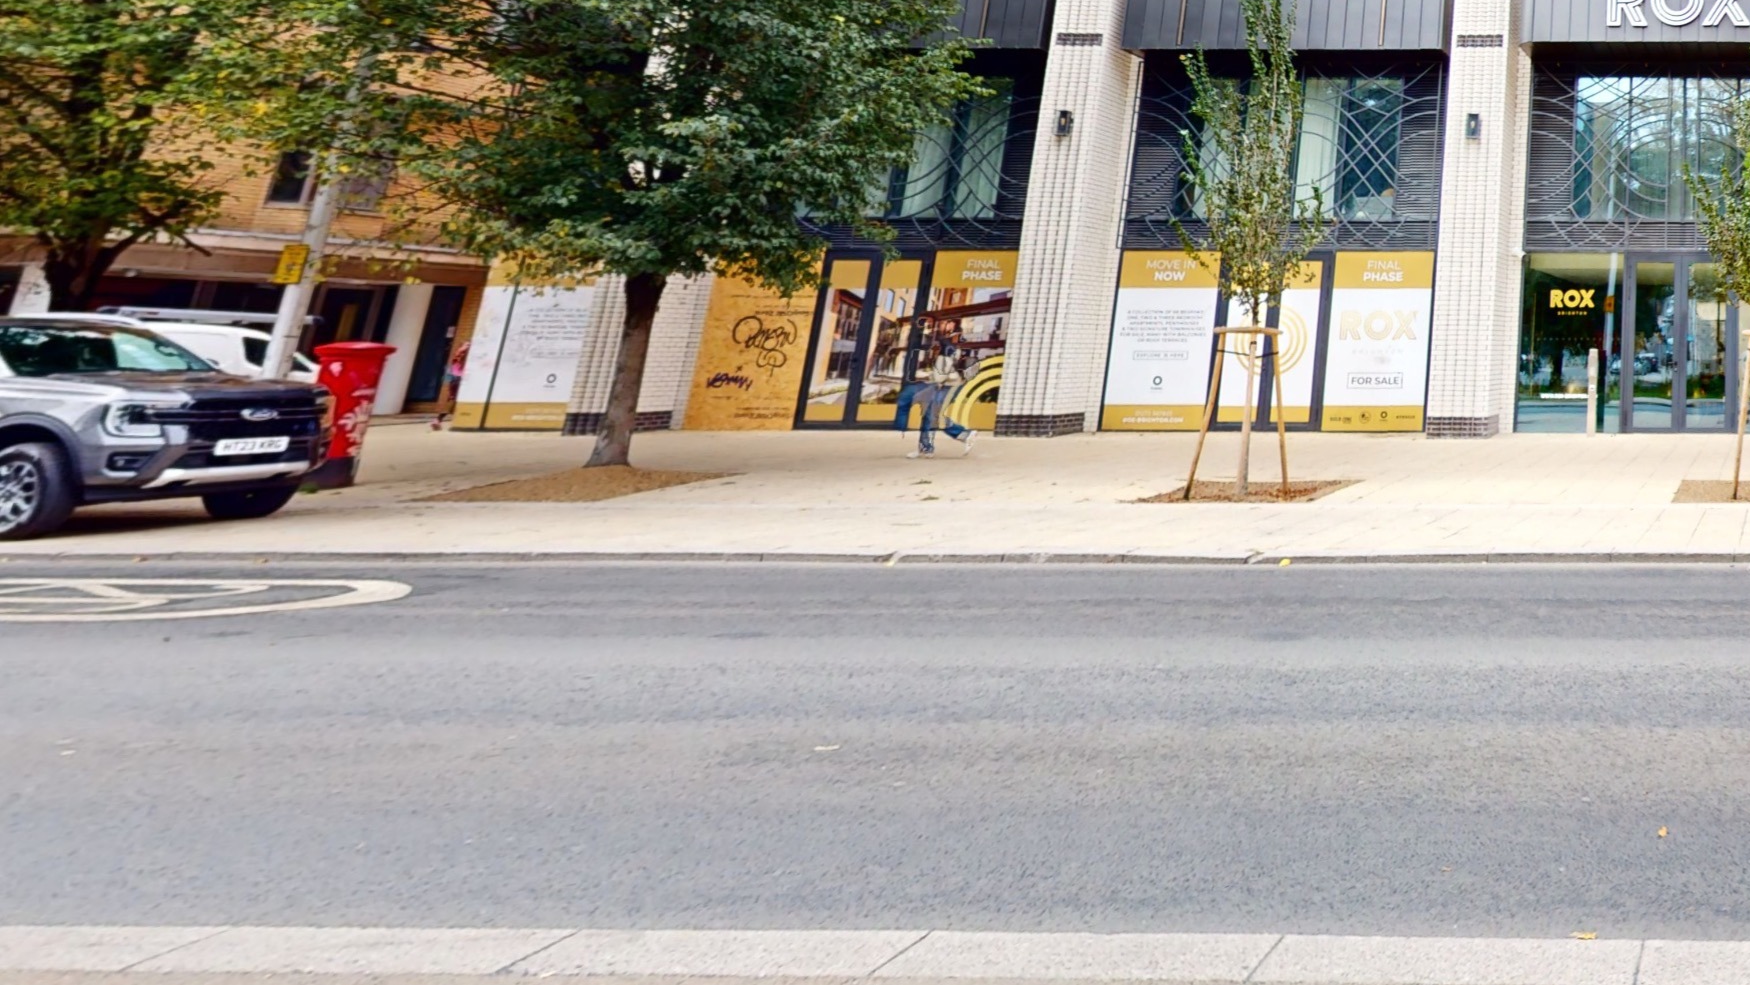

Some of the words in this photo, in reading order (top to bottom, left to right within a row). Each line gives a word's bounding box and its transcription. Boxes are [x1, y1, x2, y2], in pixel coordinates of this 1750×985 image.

[967, 258, 1001, 269] FINAL
[1146, 259, 1181, 270] MOVE
[1183, 259, 1197, 270] IN
[1367, 260, 1401, 270] FINAL
[962, 270, 1003, 281] PHASE
[1153, 271, 1186, 281] NOW
[1363, 271, 1404, 282] PHASE
[1549, 289, 1595, 308] ROX
[1339, 310, 1418, 341] ROX
[1350, 376, 1373, 385] FOR
[1374, 376, 1400, 385] SALE
